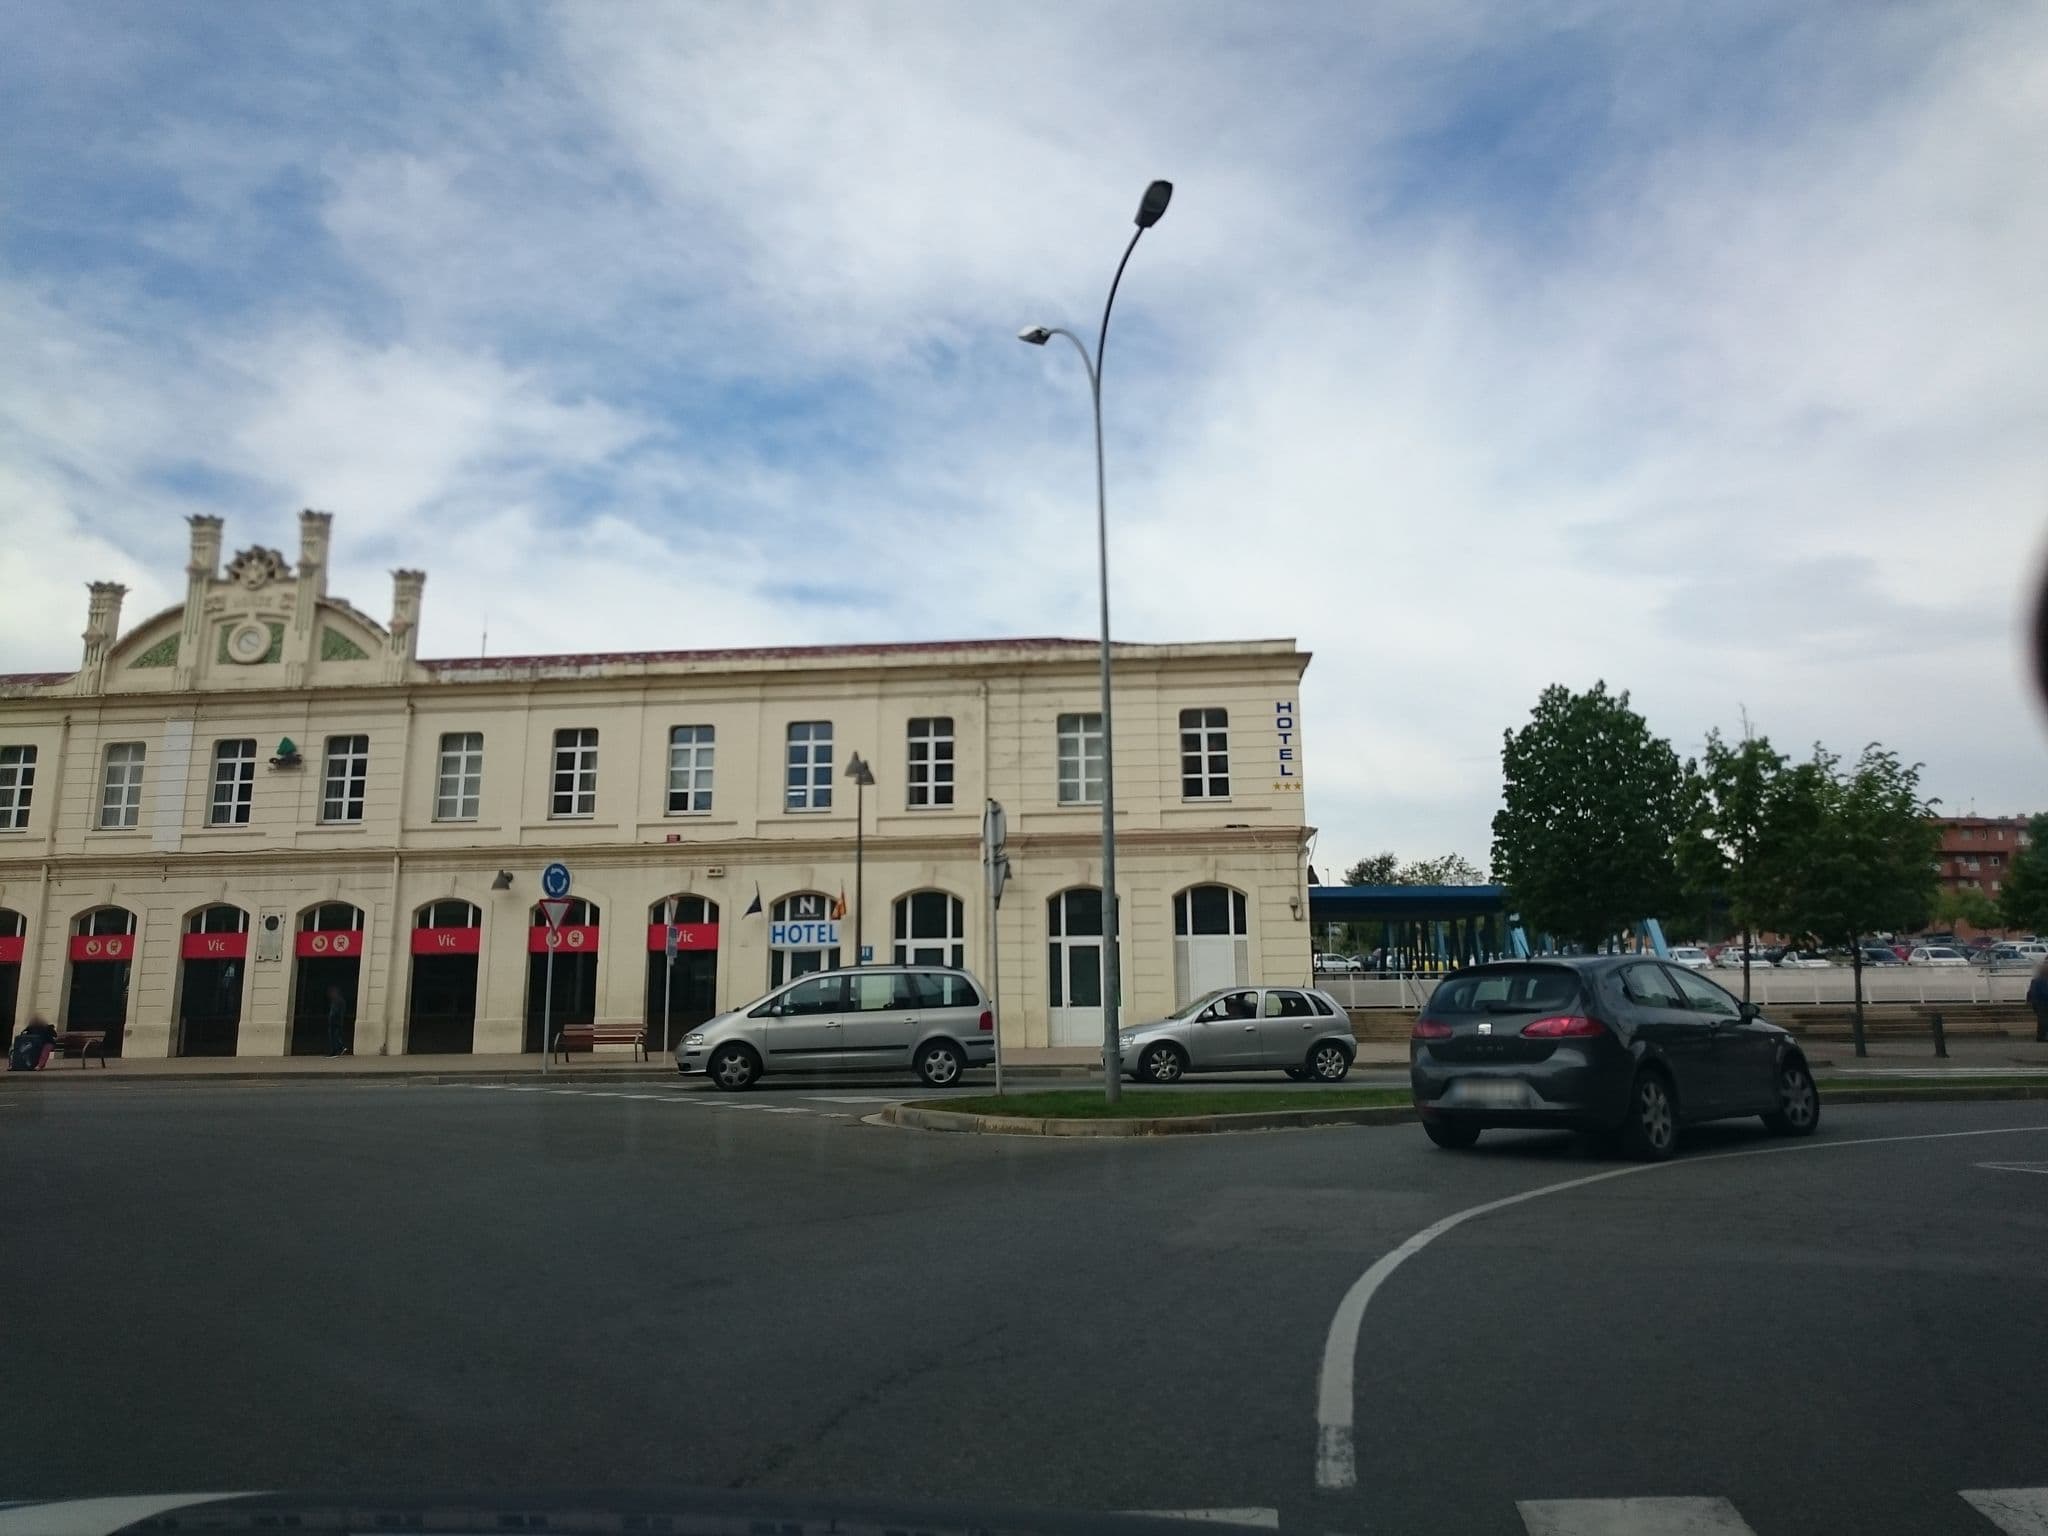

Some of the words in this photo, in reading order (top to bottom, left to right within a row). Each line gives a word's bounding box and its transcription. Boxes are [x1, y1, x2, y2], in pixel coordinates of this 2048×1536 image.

[1276, 701, 1293, 777] HOTEL
[800, 896, 815, 914] N
[438, 934, 457, 947] Vic
[772, 924, 838, 944] HOTEL
[208, 939, 225, 951] Vic
